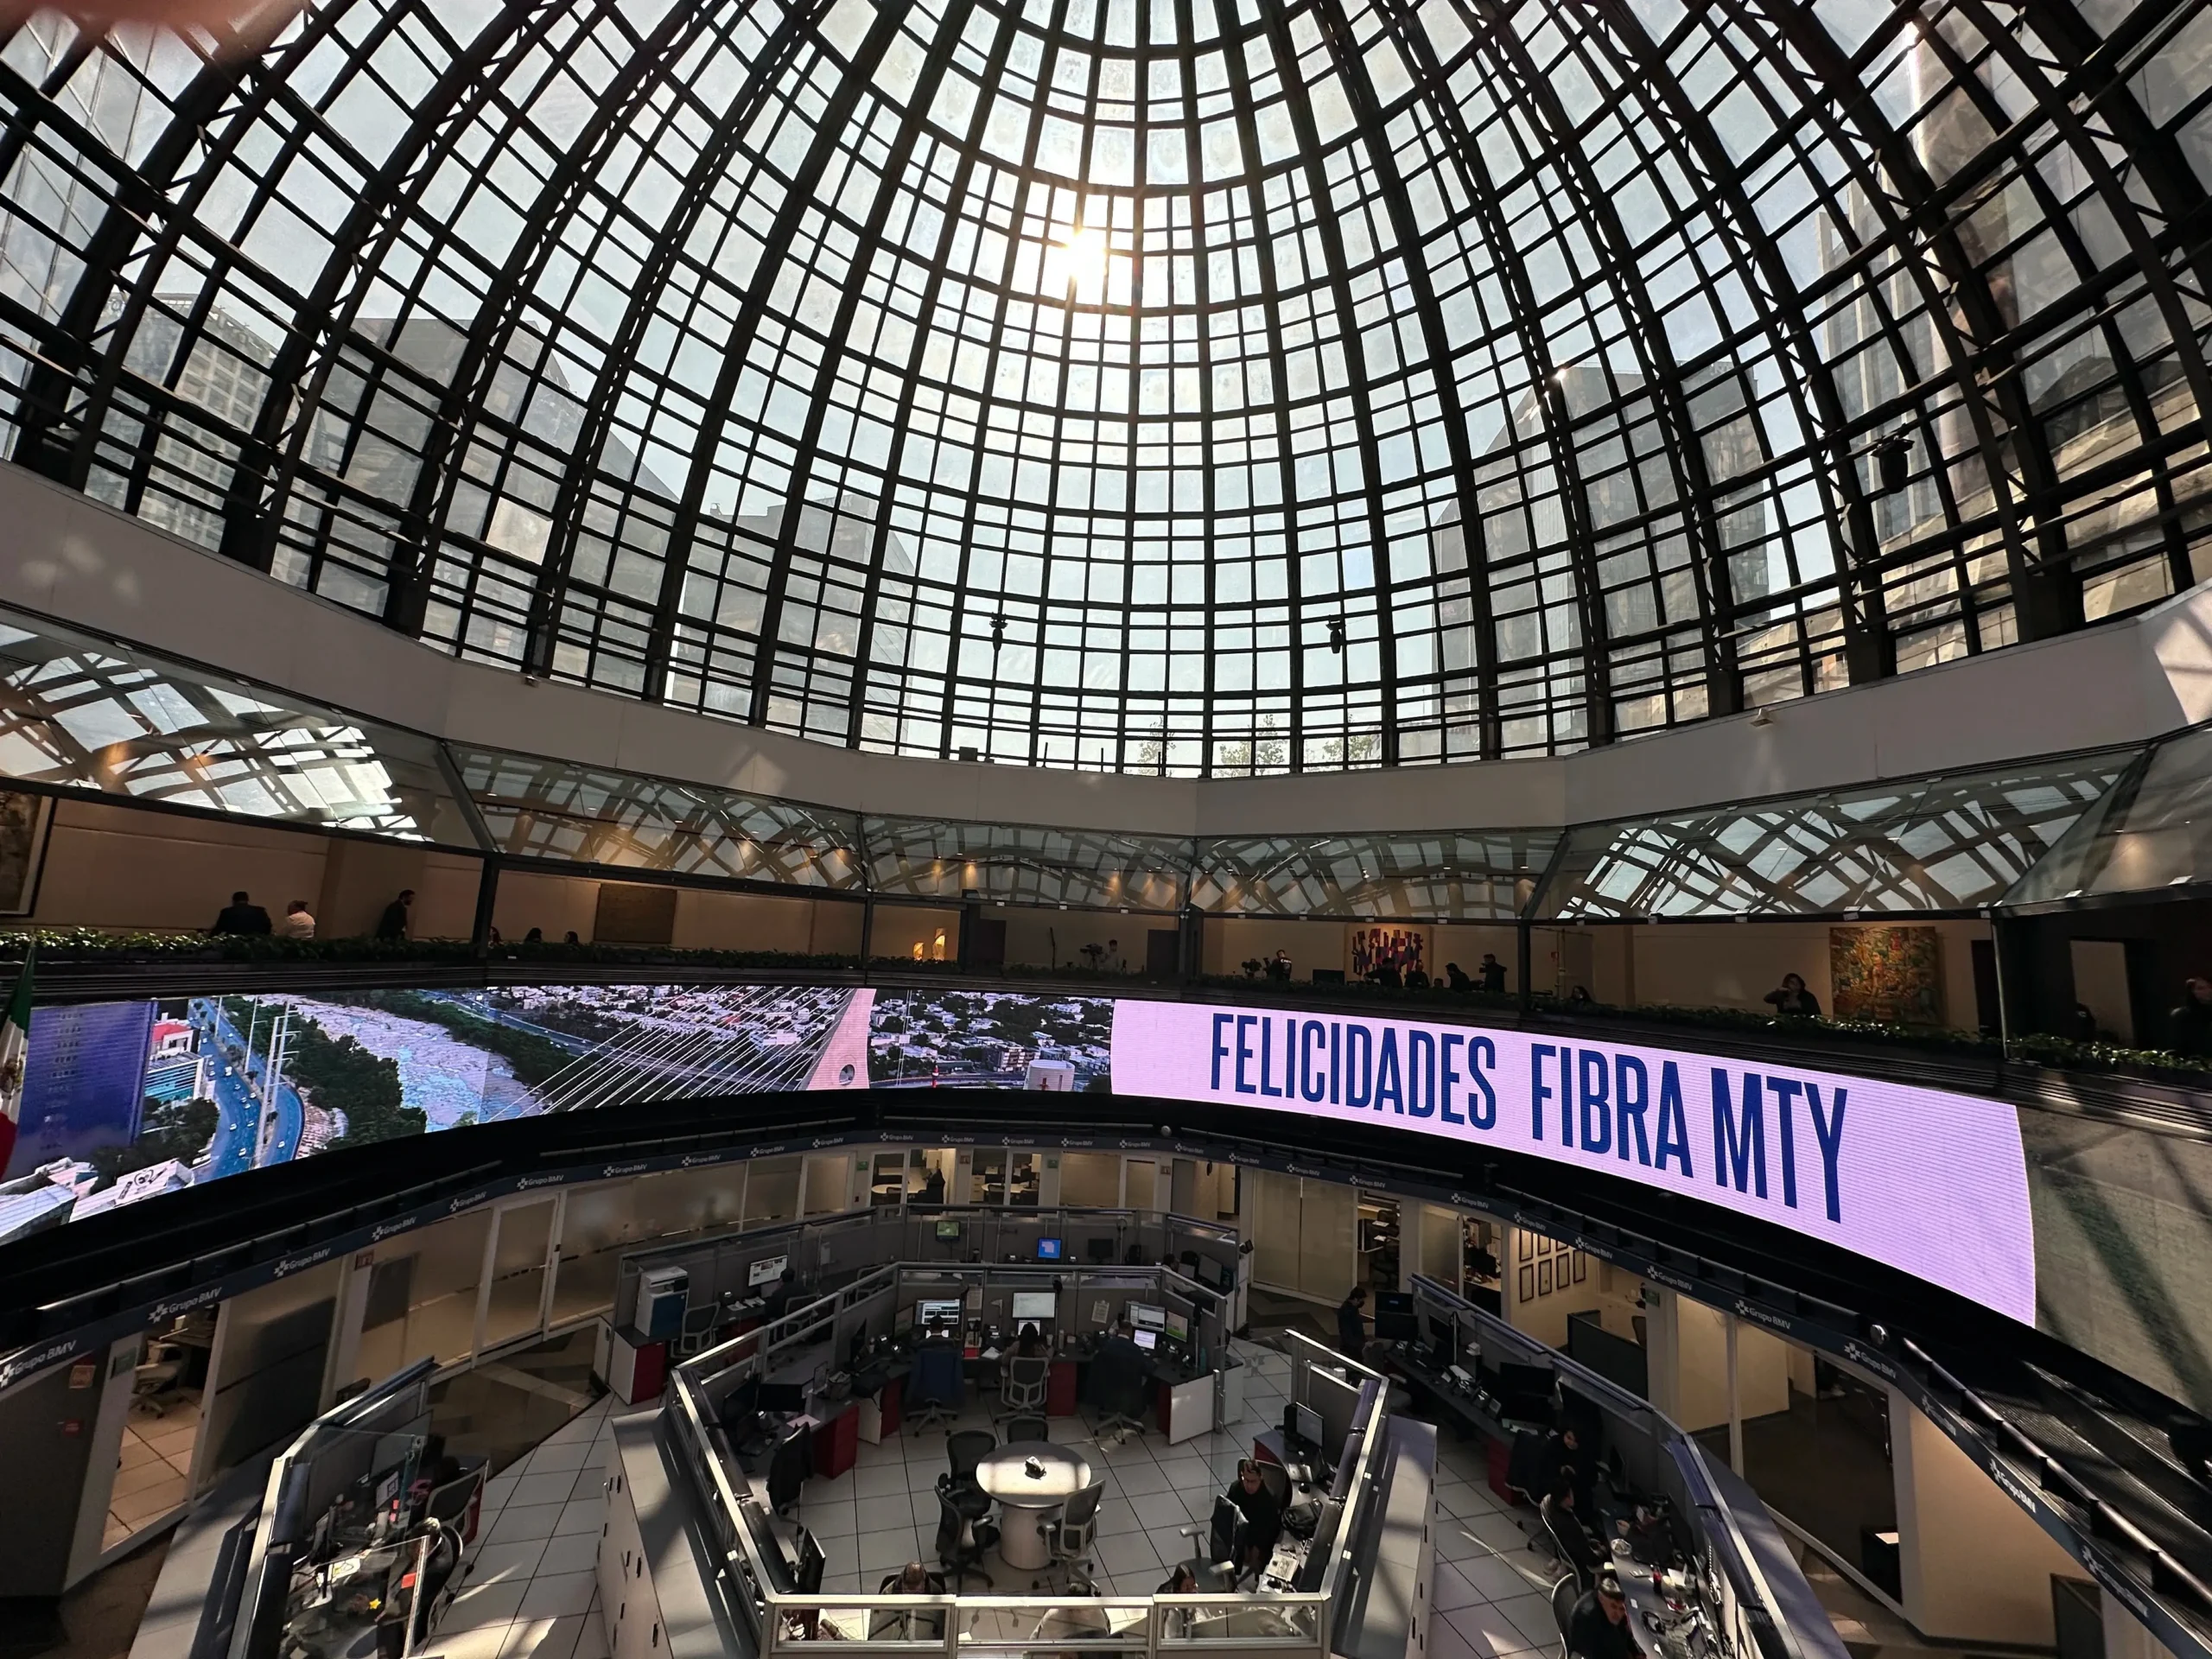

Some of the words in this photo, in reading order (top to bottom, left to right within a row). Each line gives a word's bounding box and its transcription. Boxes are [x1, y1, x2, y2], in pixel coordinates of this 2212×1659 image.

[1211, 1013, 1496, 1130] FELICIDADES
[1531, 1043, 1694, 1179] FIBRA
[1711, 1067, 1847, 1224] MTY
[528, 1178, 548, 1186] Grupo
[548, 1174, 564, 1183] BMV
[459, 1198, 475, 1207] Grupo
[474, 1192, 486, 1201] BMV
[384, 1224, 402, 1234] Grupo
[402, 1217, 416, 1227] BMV
[289, 1256, 311, 1269] Grupo
[313, 1248, 330, 1261] BMV
[1659, 1272, 1676, 1285] Grupo
[1676, 1279, 1692, 1290] BMV
[168, 1297, 198, 1313] Grupo
[198, 1287, 222, 1303] BMV
[1749, 1308, 1771, 1323] Grupo
[1772, 1316, 1790, 1329] BMV
[15, 1353, 46, 1375] Grupo
[47, 1340, 77, 1360] BMV
[1861, 1354, 1881, 1370] Grupo
[1881, 1363, 1896, 1378] BMV
